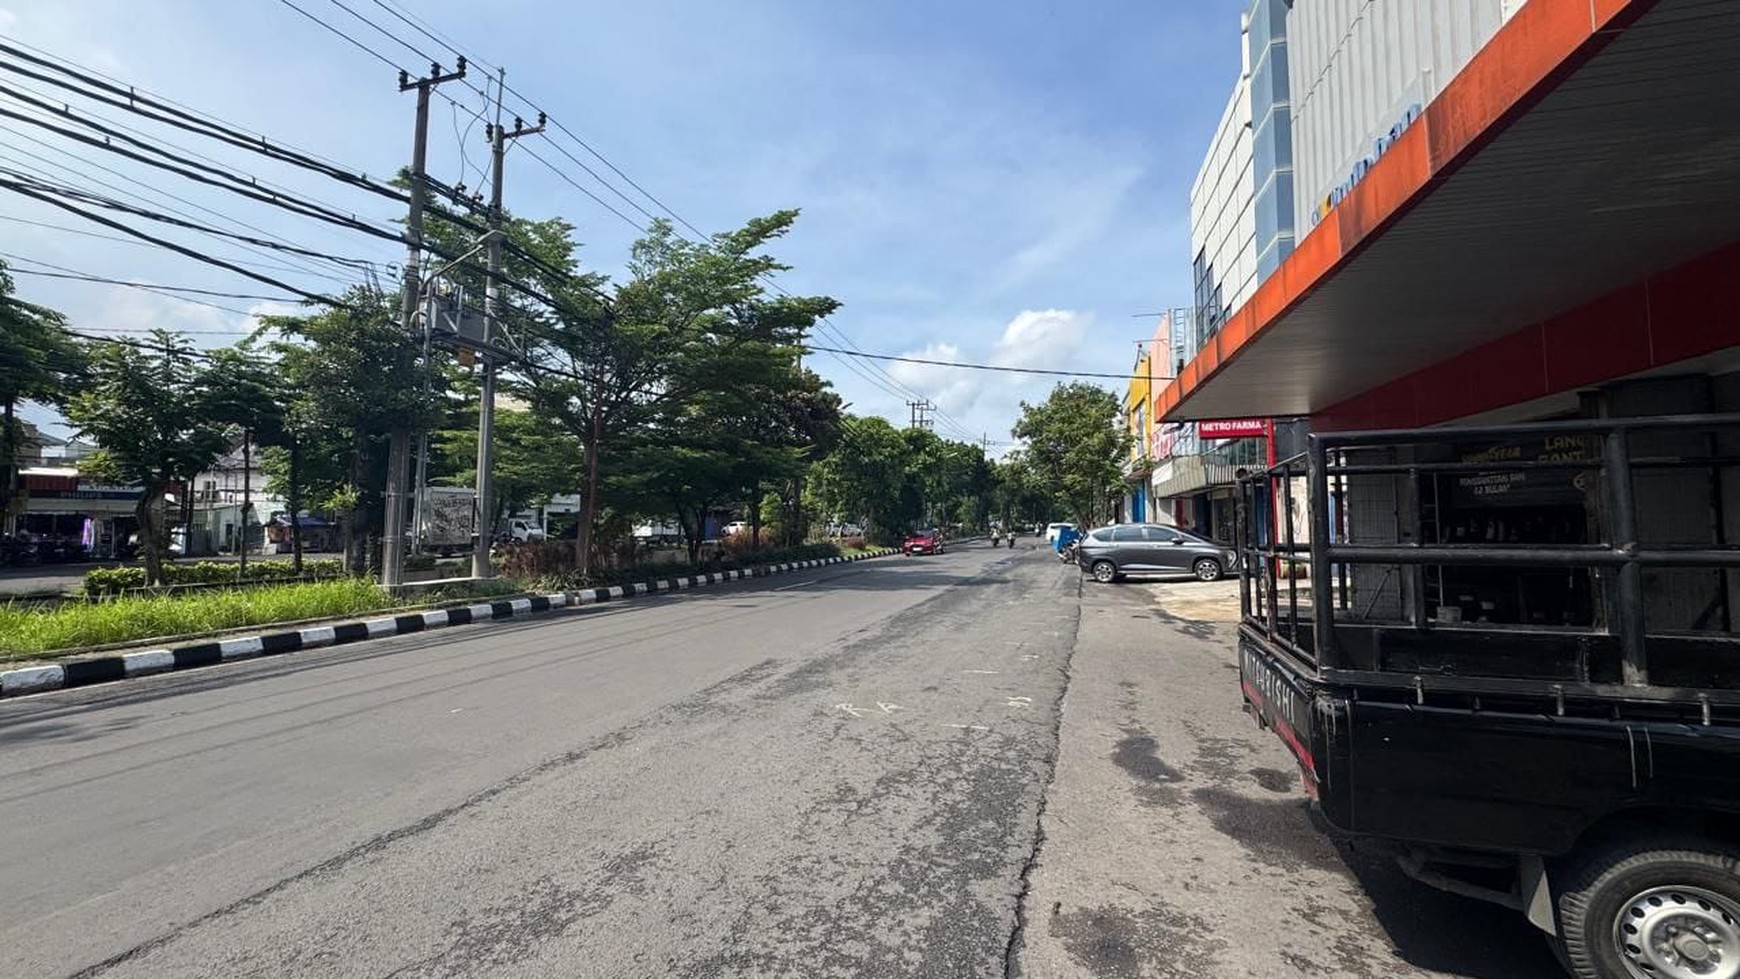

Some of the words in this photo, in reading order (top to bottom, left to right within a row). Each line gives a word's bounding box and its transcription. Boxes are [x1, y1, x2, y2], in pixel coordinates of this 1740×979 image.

[1201, 421, 1231, 432] METRO
[1232, 420, 1262, 431] FARMA
[1243, 649, 1295, 722] MITSUBISHI
